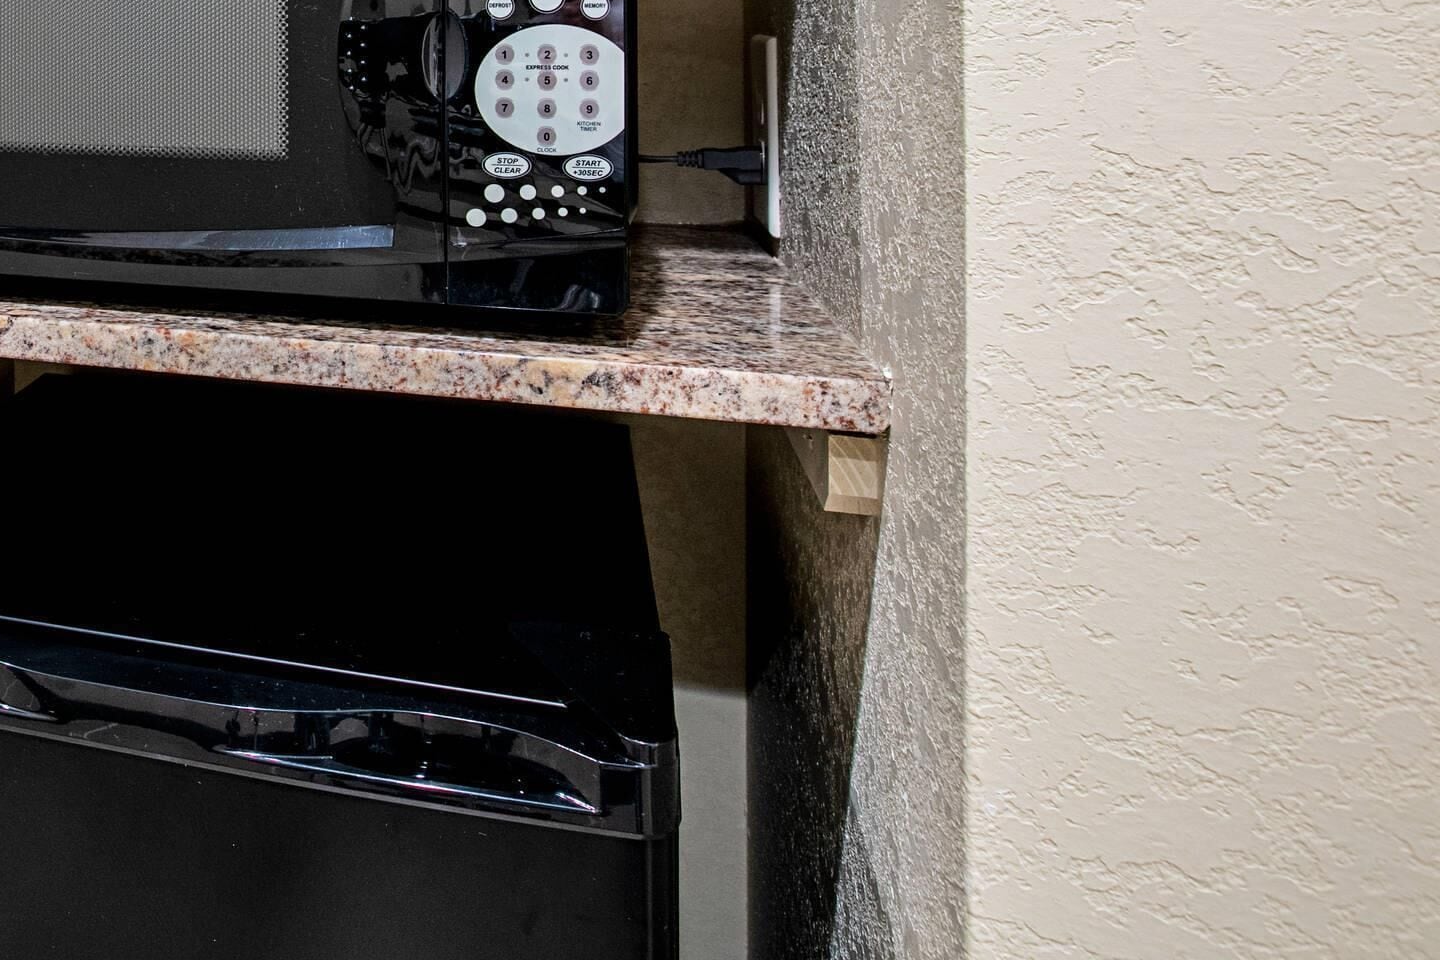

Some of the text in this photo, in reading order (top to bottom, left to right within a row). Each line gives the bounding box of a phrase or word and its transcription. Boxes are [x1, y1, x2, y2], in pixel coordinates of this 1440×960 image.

[501, 50, 507, 59] 1
[544, 50, 551, 60] 2
[586, 50, 593, 60] 3
[501, 75, 509, 85] 4
[544, 76, 551, 85] 5
[586, 76, 593, 86] 6
[501, 103, 508, 113] 7
[544, 104, 551, 113] 8
[586, 104, 593, 114] 9
[543, 132, 550, 141] 0
[575, 159, 602, 167] START
[494, 167, 522, 175] CLEAR
[573, 169, 604, 177] +30SEC
